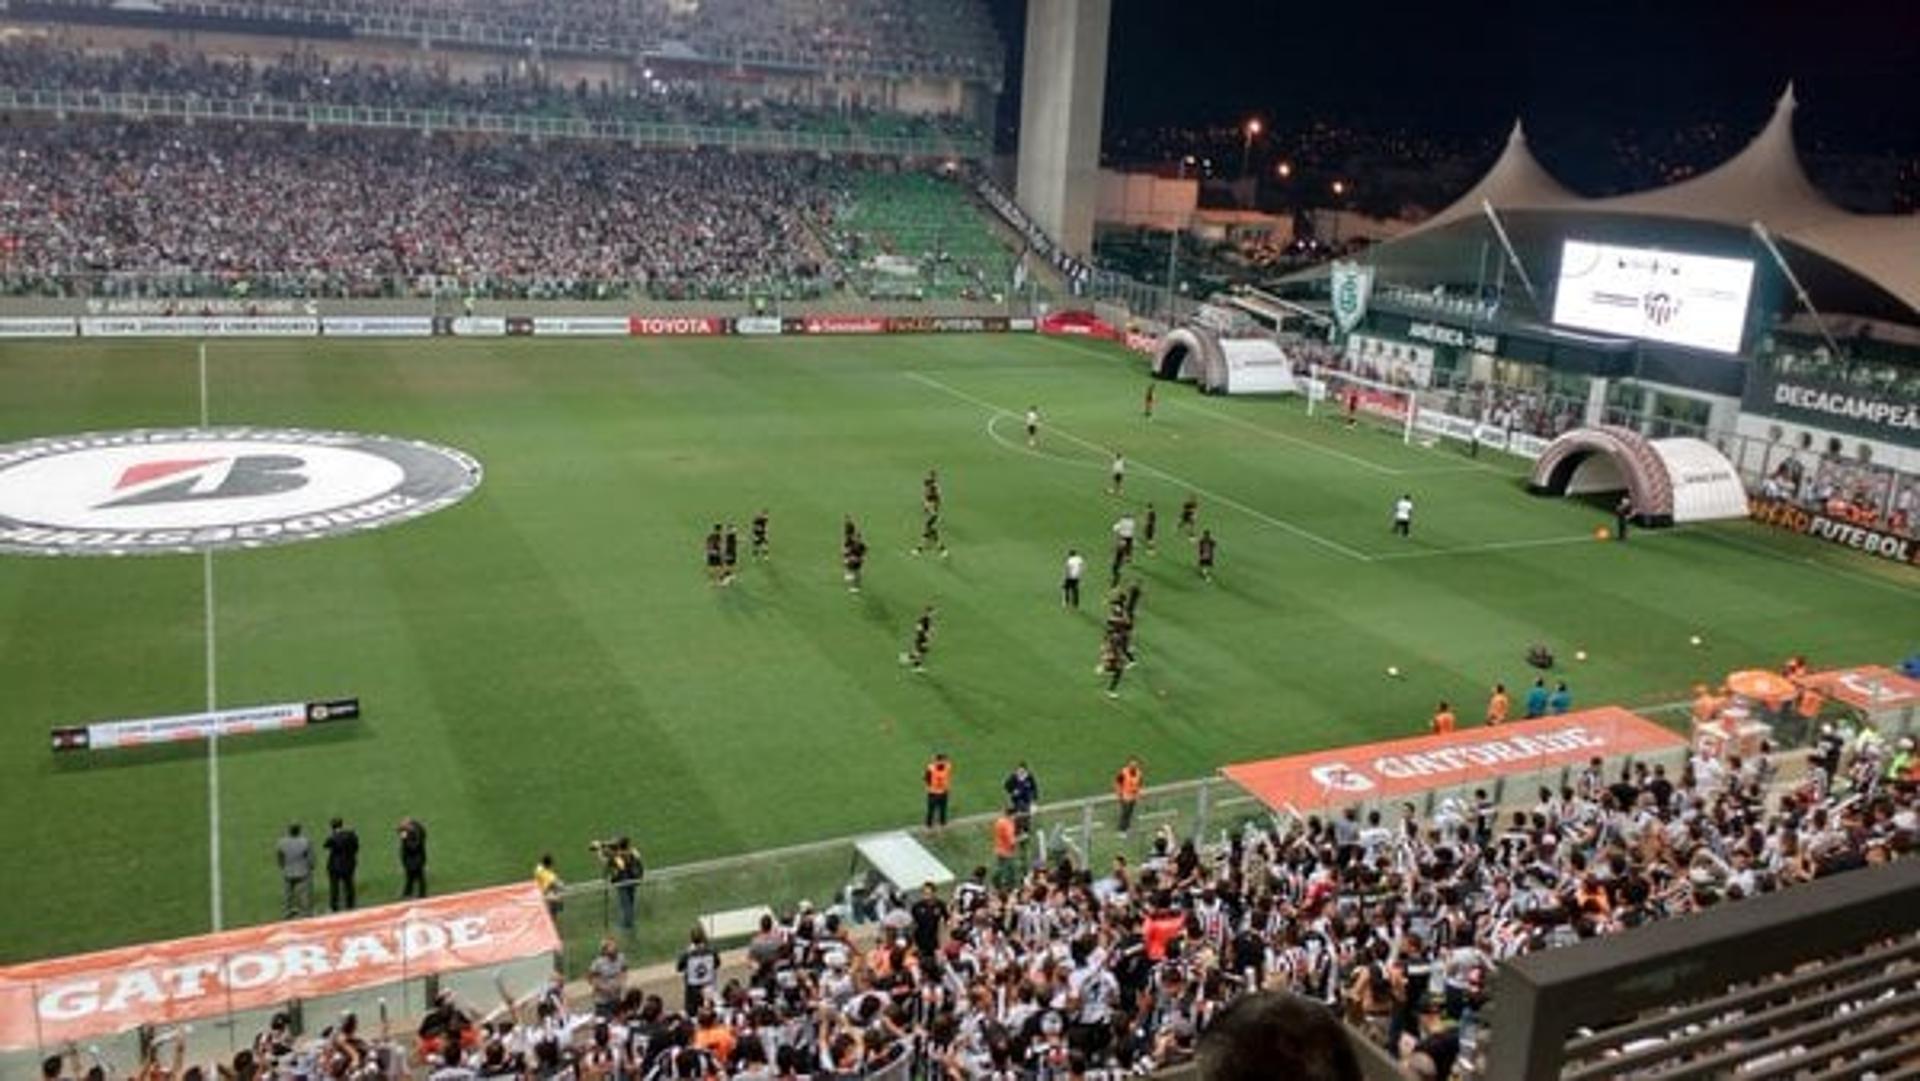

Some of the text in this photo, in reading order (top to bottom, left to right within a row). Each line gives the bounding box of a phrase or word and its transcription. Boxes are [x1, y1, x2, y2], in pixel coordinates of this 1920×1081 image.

[639, 318, 711, 334] TOYOTA
[1809, 515, 1910, 561] FUTEBOL
[1373, 725, 1605, 778] GATORADE
[37, 916, 496, 1019] GATORADE
